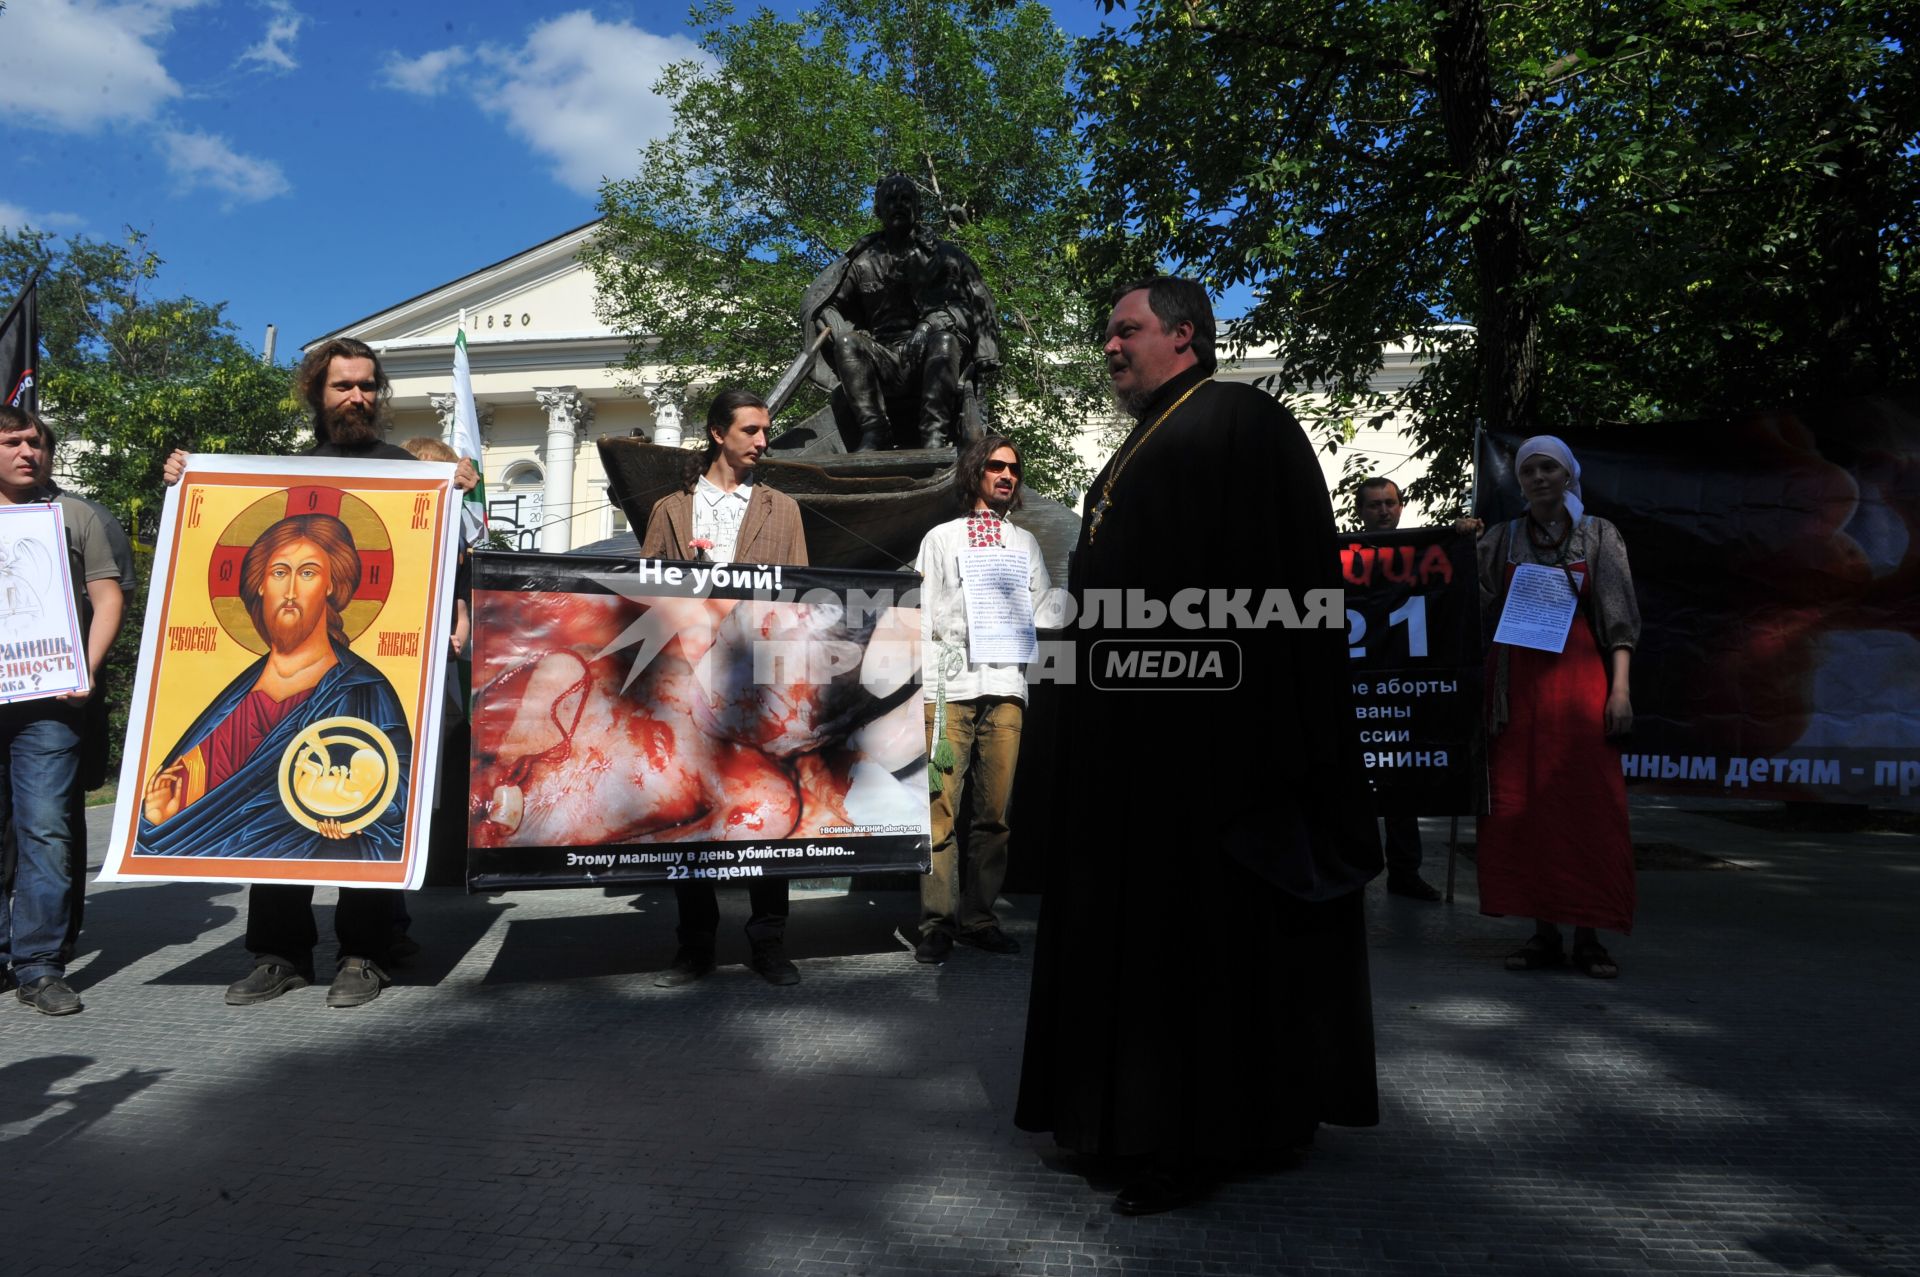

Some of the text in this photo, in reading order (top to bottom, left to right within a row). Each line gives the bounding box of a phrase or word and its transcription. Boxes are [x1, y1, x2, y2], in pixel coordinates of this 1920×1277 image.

[473, 313, 531, 330] 1830
[640, 558, 783, 595] Не убий!
[1376, 678, 1457, 697] аборты
[1724, 757, 1840, 788] детям
[885, 824, 921, 833] aborty.org
[566, 853, 615, 868] Этому
[619, 851, 683, 866] малышу
[687, 853, 696, 862] в
[699, 850, 735, 864] день
[737, 846, 804, 861] убийства
[666, 864, 763, 881] 22 недели
